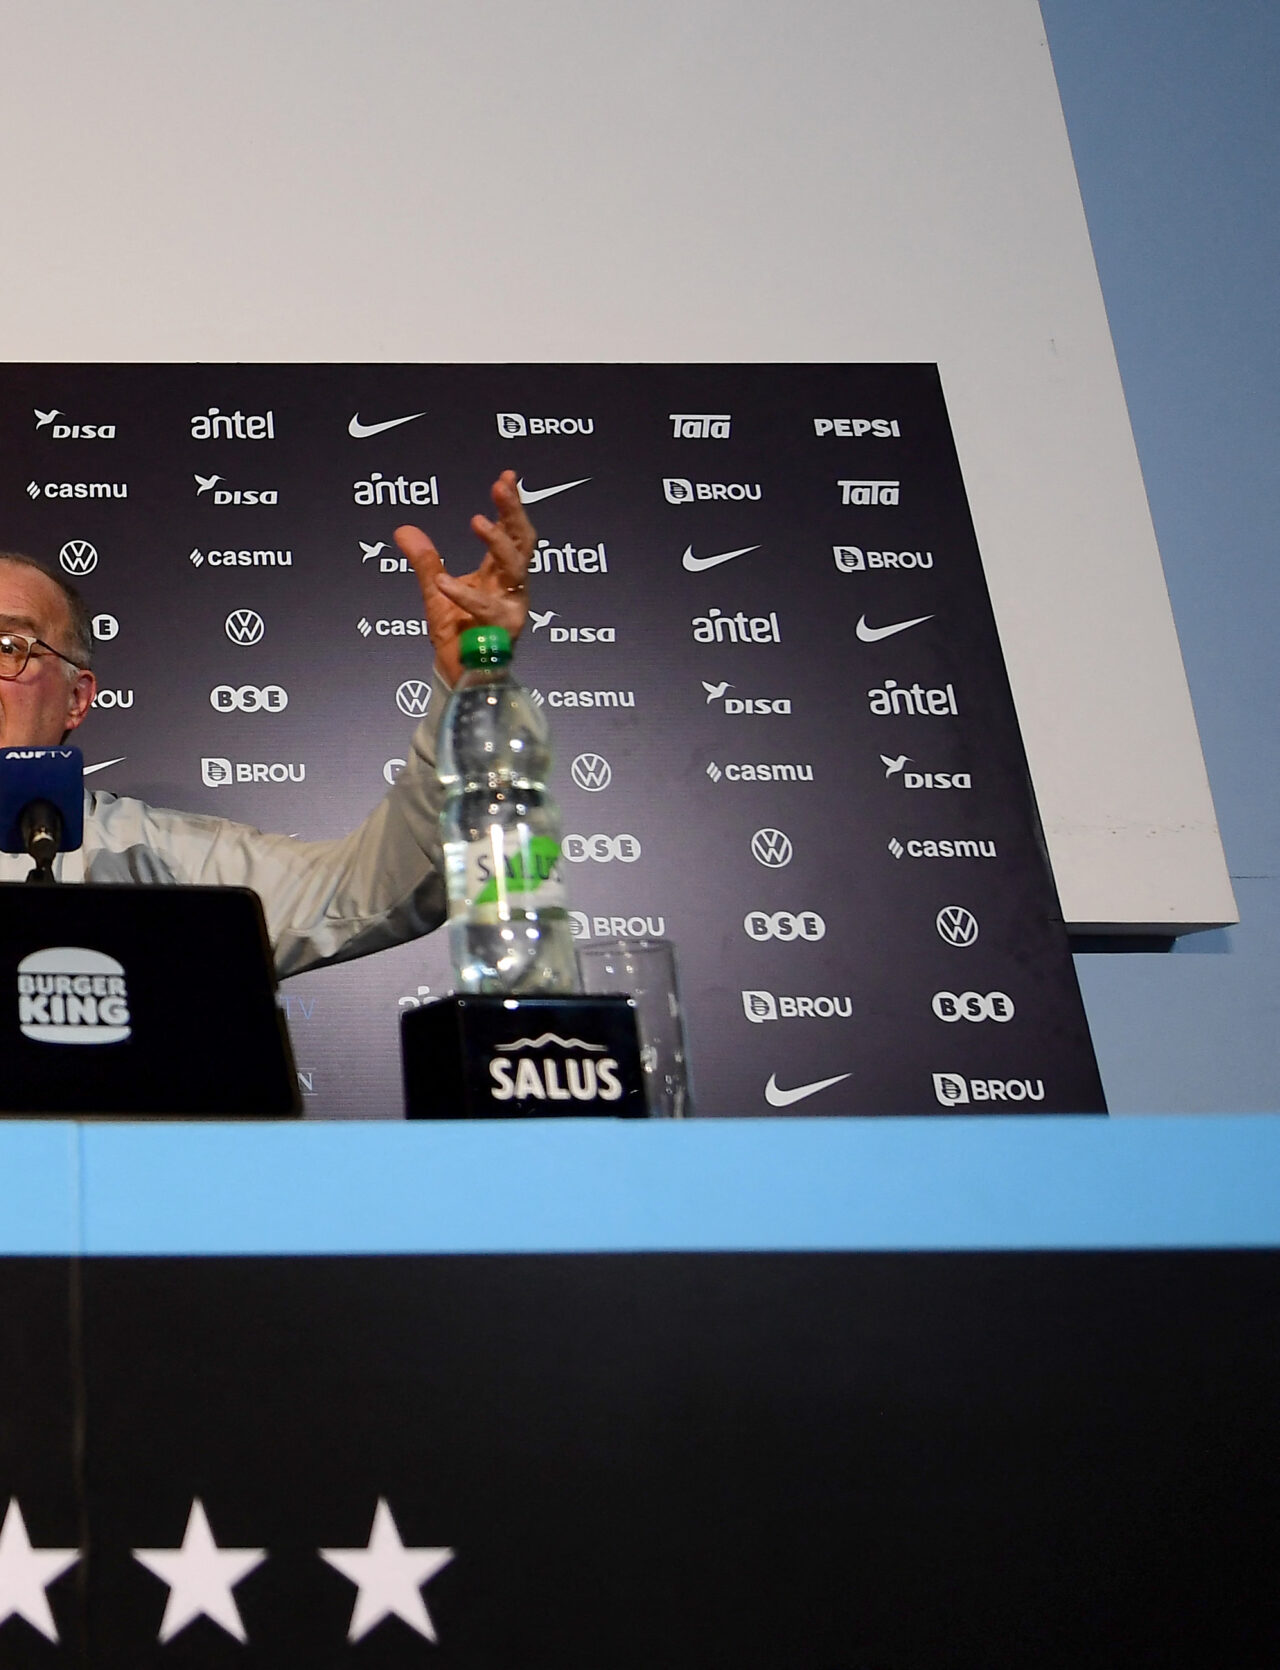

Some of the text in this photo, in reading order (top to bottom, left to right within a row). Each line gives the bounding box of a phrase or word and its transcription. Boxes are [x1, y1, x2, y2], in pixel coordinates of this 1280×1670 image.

[191, 408, 274, 439] antel
[530, 419, 593, 434] BROU
[814, 419, 900, 437] PEPSI
[45, 484, 127, 498] casmu
[354, 473, 438, 504] antel
[696, 484, 761, 500] BROU
[208, 551, 291, 565] casmu
[867, 552, 933, 568] BROU
[375, 619, 430, 636] cas
[692, 609, 780, 642] antel
[92, 689, 134, 709] OU
[213, 688, 285, 710] BSE
[548, 692, 635, 707] casmu
[868, 680, 958, 715] antel
[237, 764, 305, 782] BROU
[725, 765, 813, 780] casmu
[565, 836, 638, 860] BSE
[907, 841, 996, 857] casmu
[593, 917, 664, 936] BROU
[747, 914, 822, 939] BSE
[17, 975, 126, 996] BURGER
[20, 997, 131, 1025] KING
[779, 997, 852, 1017] BROU
[935, 994, 1011, 1020] BSE
[488, 1057, 623, 1101] SALUS
[970, 1080, 1044, 1100] BROU
